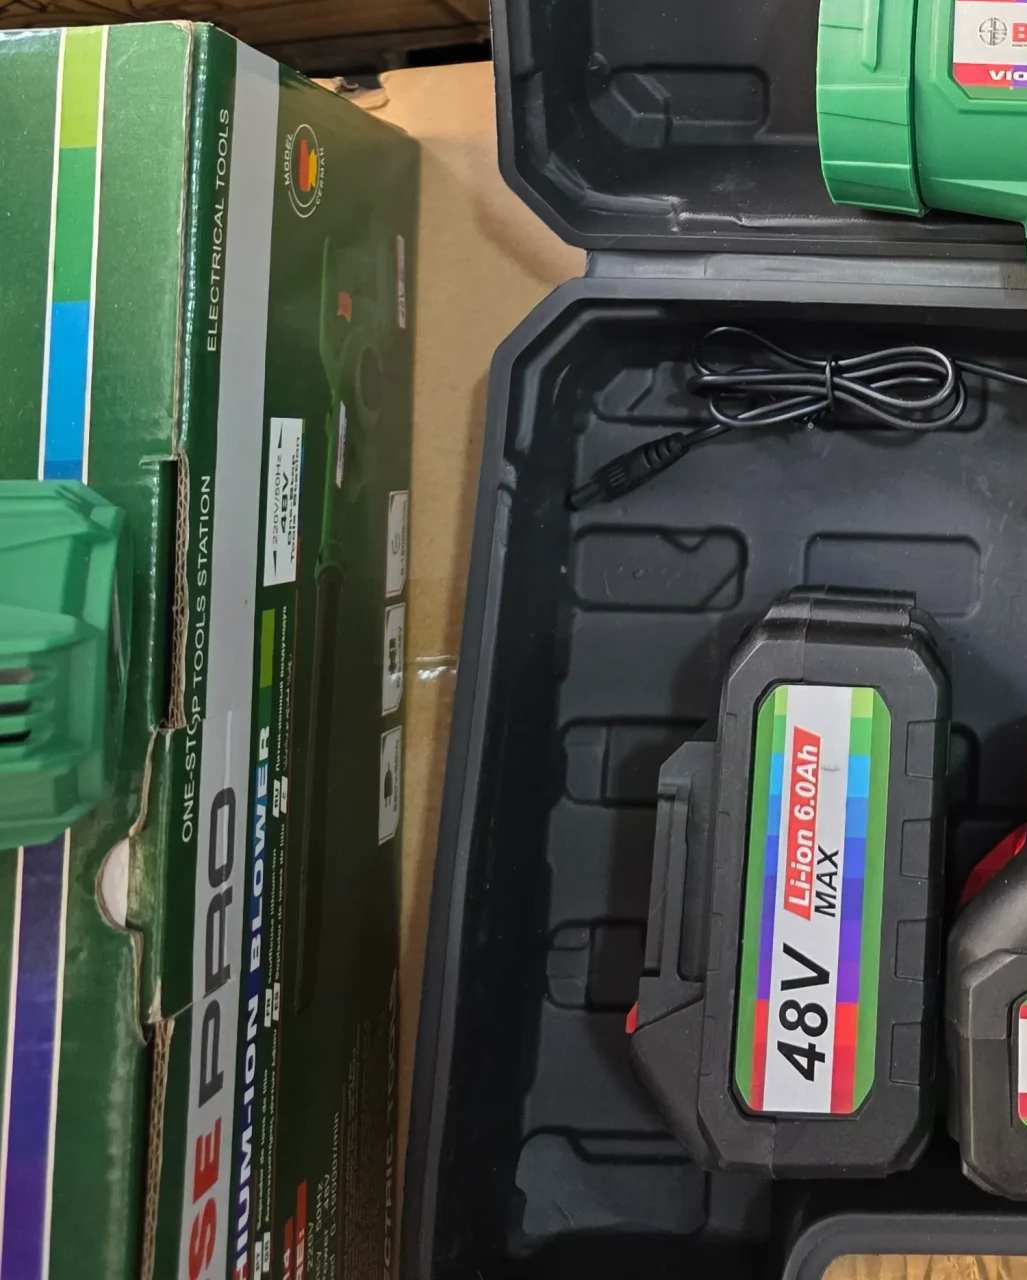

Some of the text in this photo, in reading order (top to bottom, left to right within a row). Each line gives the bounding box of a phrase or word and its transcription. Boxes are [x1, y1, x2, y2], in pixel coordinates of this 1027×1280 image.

[284, 133, 294, 186] MODEL
[206, 108, 230, 352] ELECTRICAL TOOLS
[196, 474, 212, 587] STATION
[280, 471, 289, 534] 48V
[193, 592, 207, 689] TOOLS
[250, 725, 271, 973] BLOWER
[814, 845, 840, 918] MAX
[199, 786, 236, 1109] PRO
[777, 744, 831, 1083] 48V Li-ion 6.0Ah
